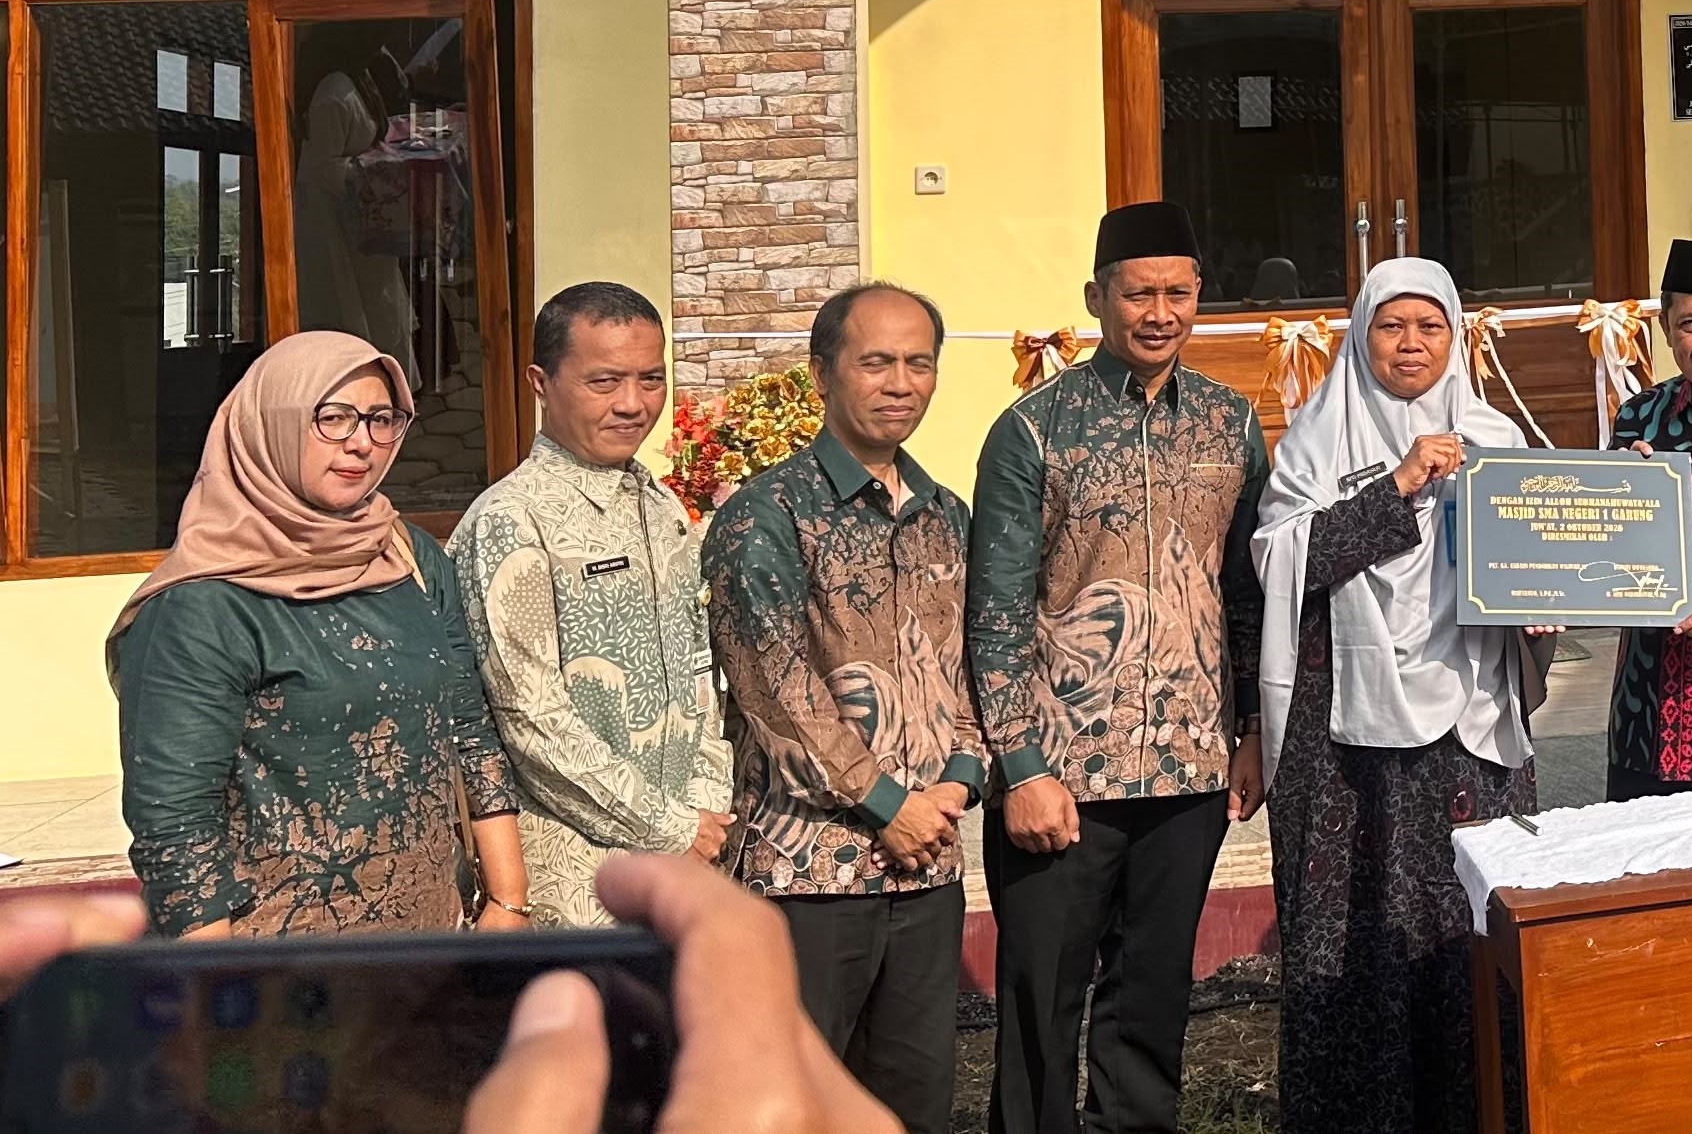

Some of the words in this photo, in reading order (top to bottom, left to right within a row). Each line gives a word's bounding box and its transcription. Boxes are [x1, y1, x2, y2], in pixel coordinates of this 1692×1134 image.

[1490, 496, 1523, 505] DENGAN
[1498, 506, 1536, 521] MASJID
[1538, 508, 1559, 520] SMA
[1562, 508, 1600, 520] NEGERI
[1602, 509, 1608, 520] 1
[1612, 509, 1653, 522] GARUNG
[1560, 523, 1565, 531] 2
[1567, 523, 1601, 532] OKTOBER
